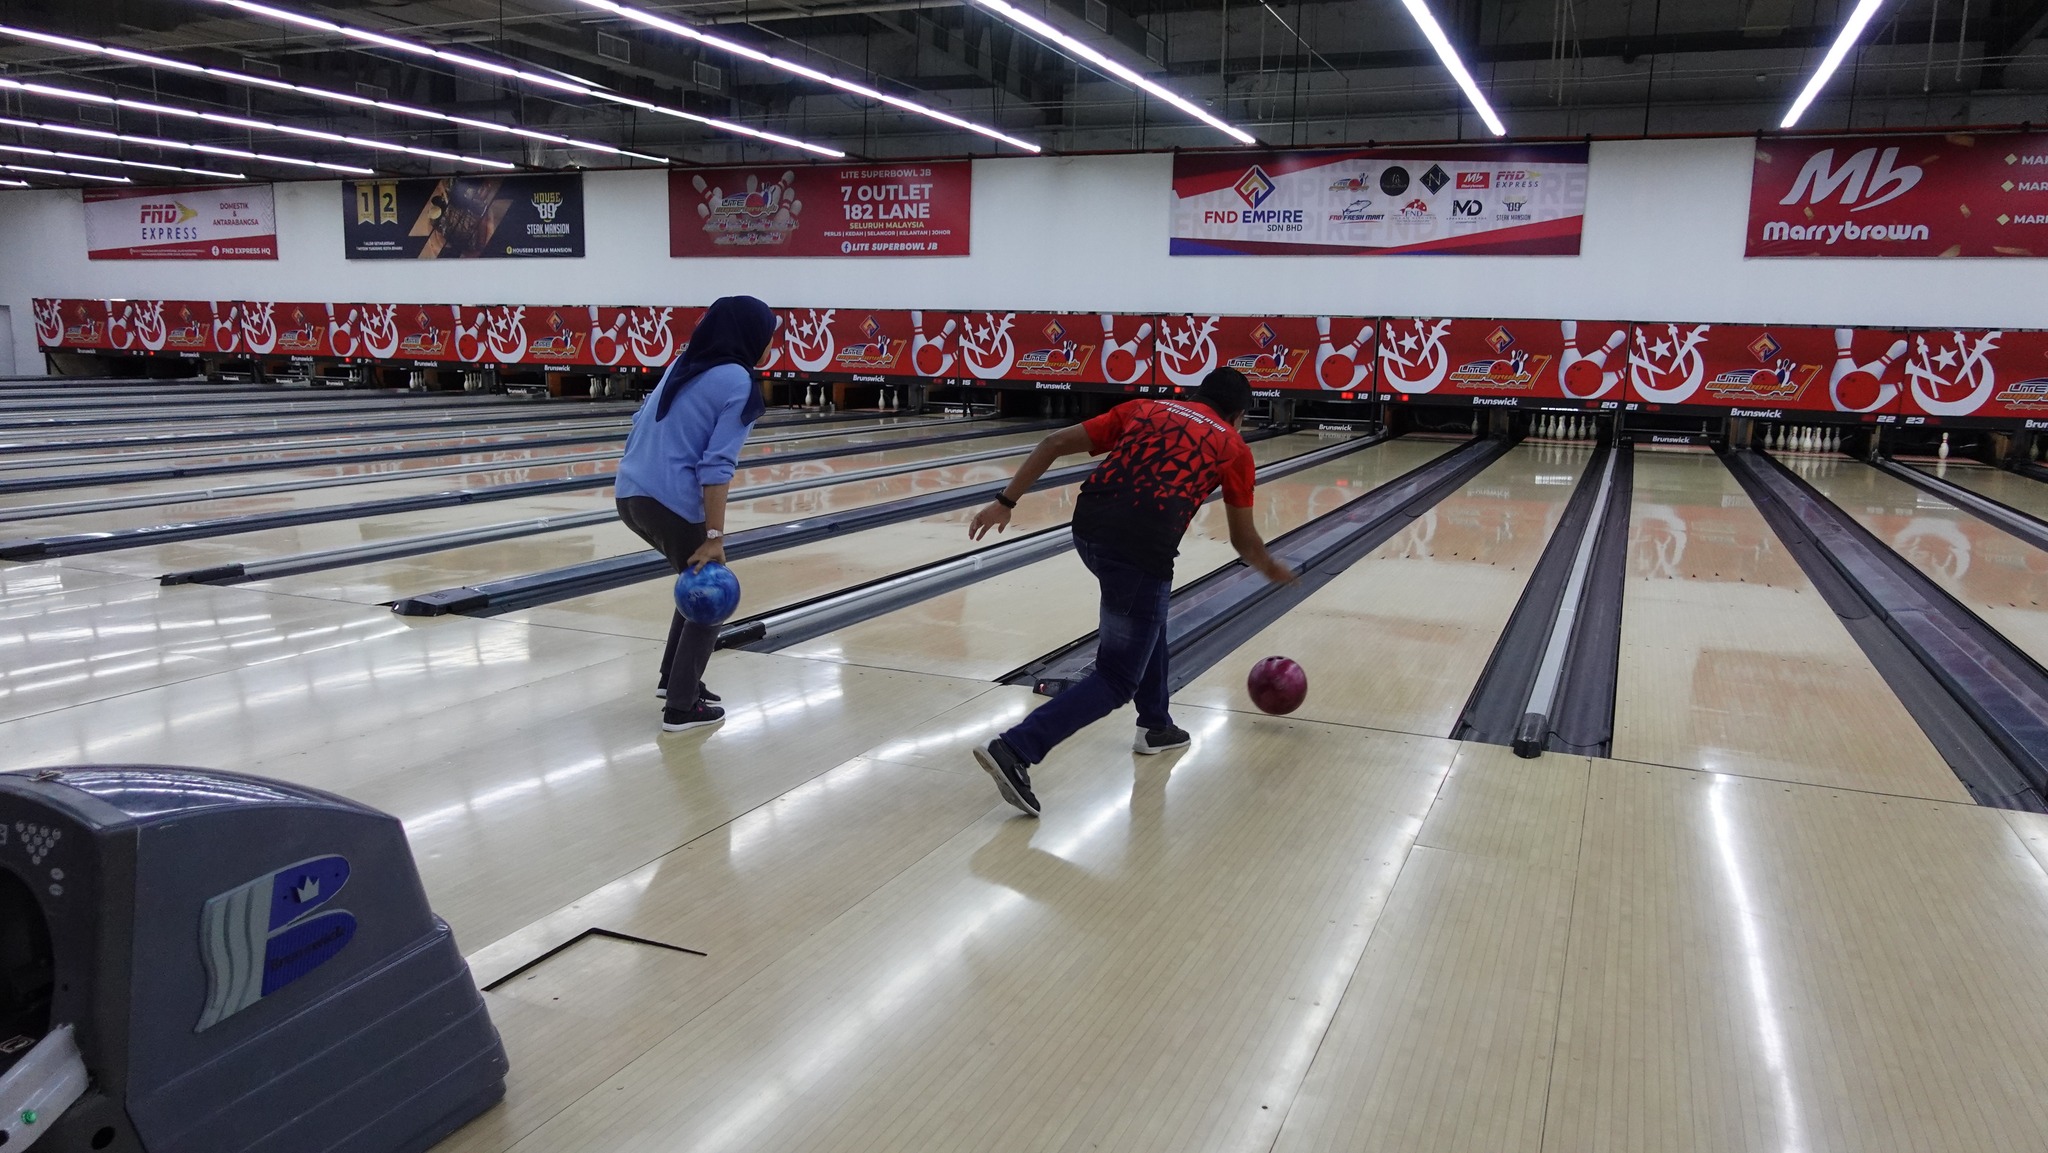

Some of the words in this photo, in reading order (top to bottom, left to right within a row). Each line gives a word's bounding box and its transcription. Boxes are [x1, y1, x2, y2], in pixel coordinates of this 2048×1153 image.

[840, 171, 859, 179] LITE
[861, 169, 918, 178] SUPERBOWL
[920, 168, 932, 177] JB
[1464, 173, 1483, 183] Mb
[1496, 170, 1526, 180] FND
[1496, 180, 1539, 188] EXPRESS
[1779, 146, 1923, 213] Mb
[533, 192, 561, 203] HOUSE
[841, 186, 852, 201] 7
[857, 183, 933, 201] OUTLET
[220, 202, 249, 210] DOMESTIK
[361, 192, 369, 212] 1
[382, 192, 394, 212] 2
[140, 204, 177, 224] FND
[539, 203, 556, 219] 89
[844, 204, 873, 220] 182
[878, 203, 930, 219] LANE
[1204, 211, 1238, 224] FND
[1242, 209, 1304, 223] EMPIRE
[212, 218, 259, 226] ANTARABANGSA
[886, 221, 924, 229] MALAYSIA
[142, 227, 198, 240] EXPRESS
[526, 223, 544, 235] STEAK
[544, 223, 570, 235] MANSION
[1286, 224, 1303, 232] BHD
[1762, 220, 1929, 245] Marrybrown
[235, 247, 261, 255] EXPRESS
[261, 247, 271, 255] HQ
[852, 243, 870, 251] LITE
[872, 242, 925, 251] SUPERBOWL
[927, 242, 938, 250] JB
[892, 340, 907, 368] 7
[414, 360, 438, 368] Brunswick
[1079, 344, 1096, 376] 7
[1289, 348, 1310, 382] 7
[544, 364, 571, 372] Brunswick
[1529, 354, 1552, 390] 7
[852, 374, 885, 382] Brunswick
[1794, 364, 1823, 402] 7
[1036, 382, 1072, 390] Brunswick
[1358, 392, 1368, 400] 18
[1472, 396, 1518, 406] Brunswick
[1730, 408, 1782, 419] Brunswick
[1876, 415, 1896, 423] 22
[1905, 416, 1925, 424] 23
[1652, 436, 1690, 444] Brunswick
